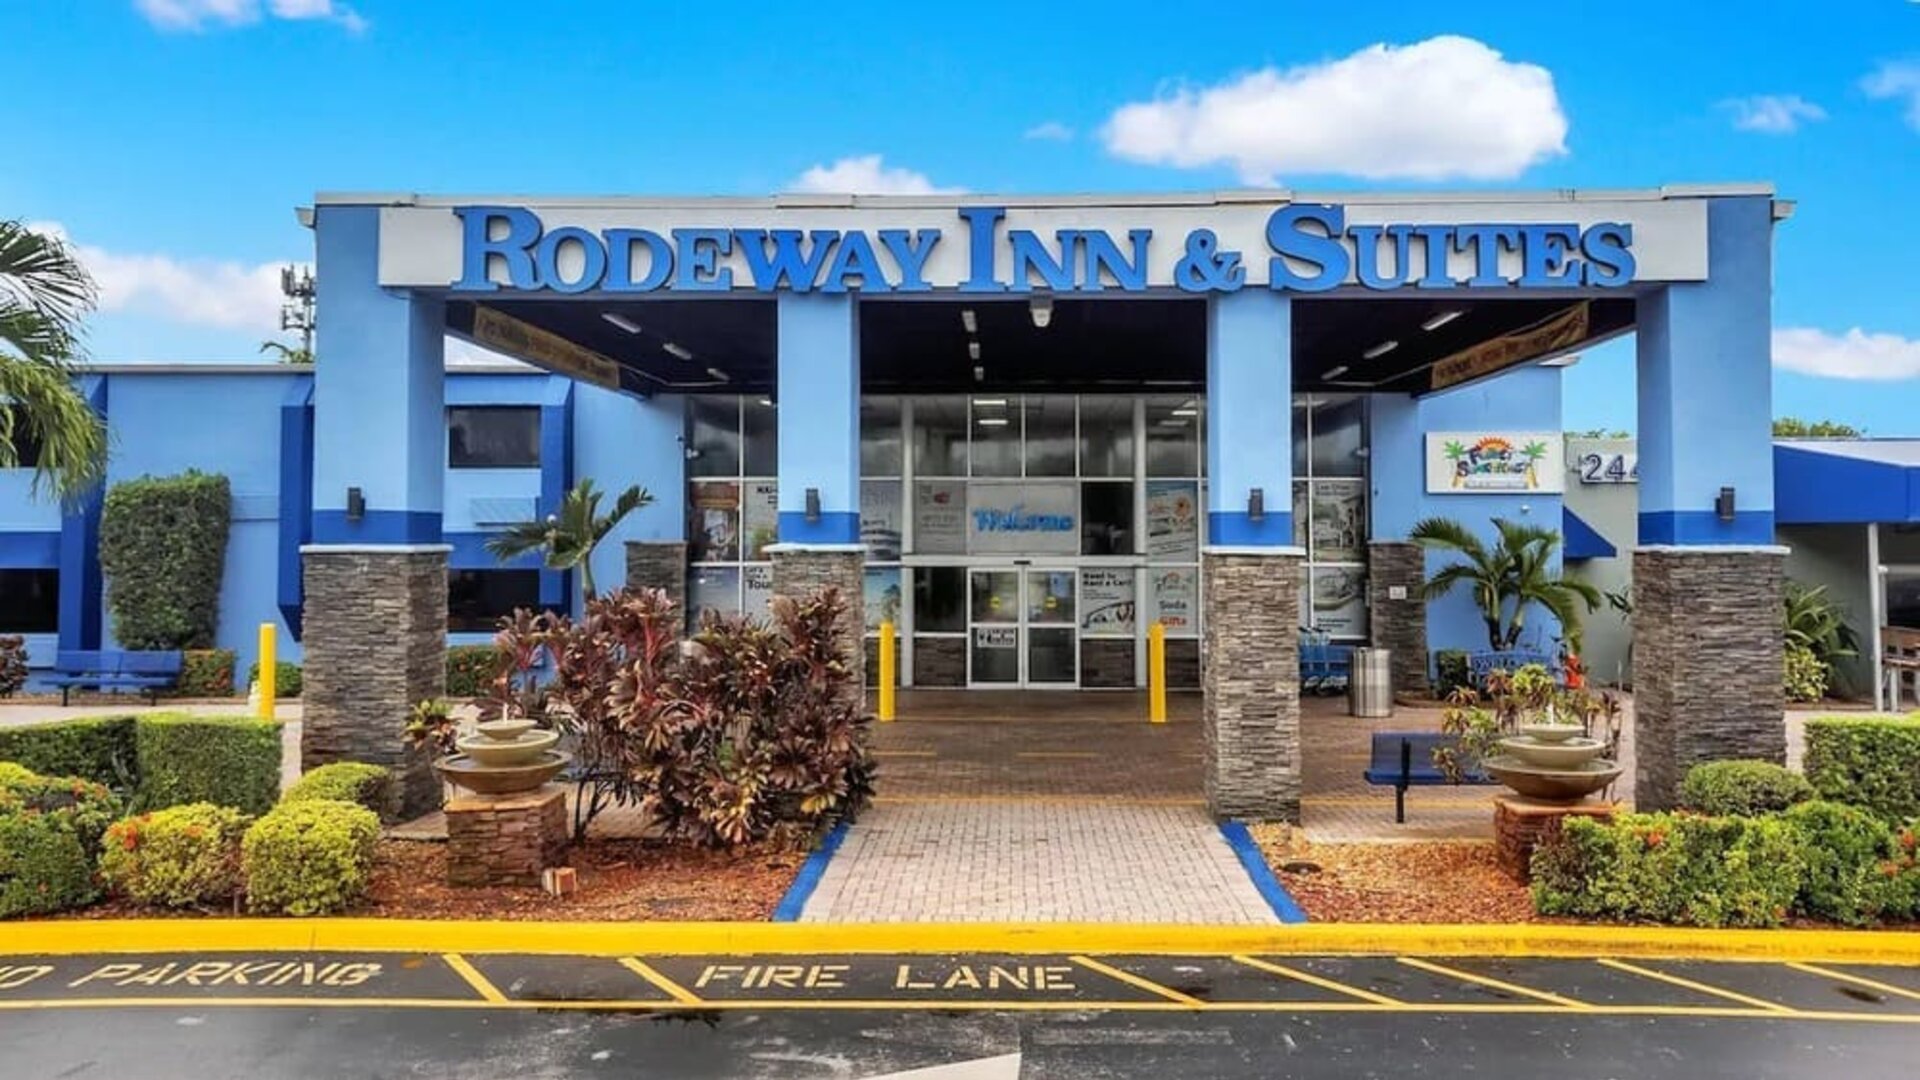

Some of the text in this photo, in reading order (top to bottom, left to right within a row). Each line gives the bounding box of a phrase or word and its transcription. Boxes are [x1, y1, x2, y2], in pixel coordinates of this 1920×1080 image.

[957, 205, 1153, 294] INN
[1173, 227, 1246, 294] &
[972, 503, 1075, 533] Welcome
[67, 960, 384, 989] PARKING
[695, 964, 1077, 990] FIRE LANE
